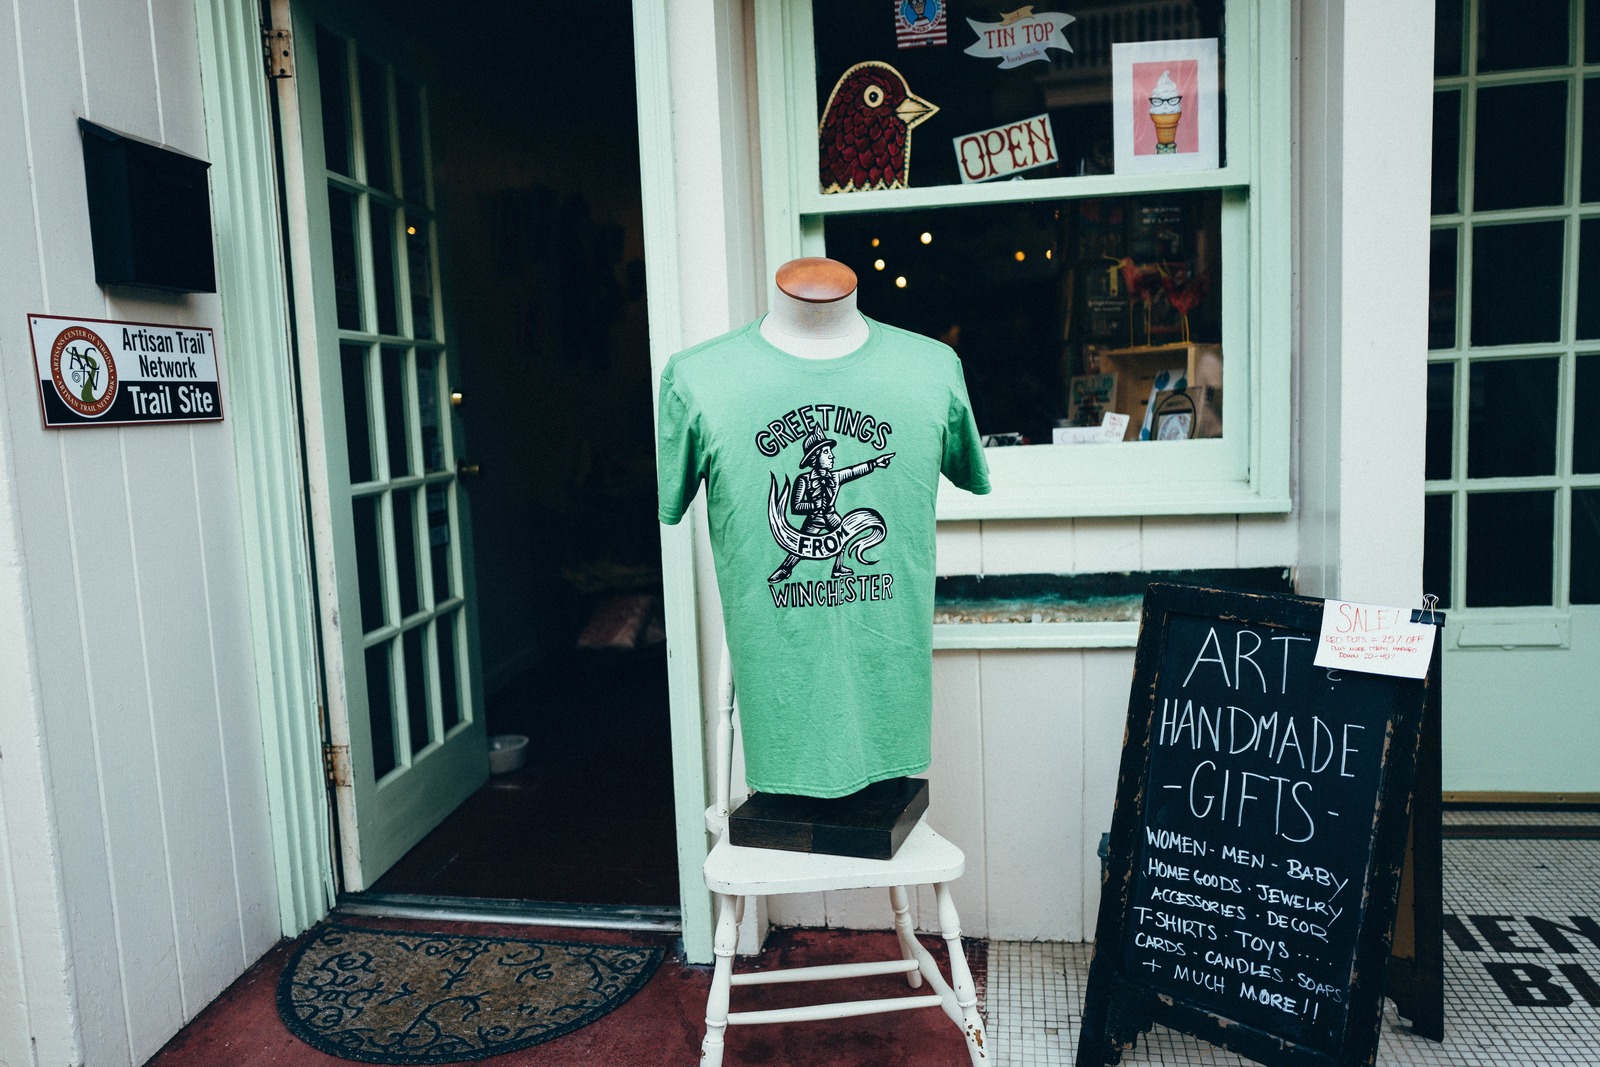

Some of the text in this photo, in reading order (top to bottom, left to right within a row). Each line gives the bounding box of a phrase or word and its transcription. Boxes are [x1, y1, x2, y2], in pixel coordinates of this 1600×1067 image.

[983, 21, 1054, 49] TIN TOP
[1006, 48, 1041, 63] handmade
[960, 117, 1054, 180] OPEN
[53, 329, 114, 373] ARTISANS CENTER OF VIRGINIA
[122, 327, 206, 354] Artisan Trail
[138, 354, 198, 379] Network
[57, 380, 115, 412] ARTISAN TRAIL NETWORK
[127, 385, 214, 415] Trail Site
[755, 404, 892, 457] GREETINGS
[798, 525, 850, 557] FROM
[768, 573, 893, 608] WINCHESTER
[1336, 603, 1400, 633] SALE!
[1325, 635, 1343, 644] RED
[1346, 635, 1367, 644] DOTS
[1405, 635, 1425, 644] OFF
[1182, 627, 1311, 694] ART
[1160, 698, 1365, 777] HANDMADE
[1222, 845, 1265, 869] MEN
[1287, 859, 1349, 903] BABY
[1133, 906, 1217, 941] T-SHIRTS
[1151, 887, 1329, 944] ACCESSORIES DECOR
[1256, 884, 1343, 928] JEWELRY
[1135, 932, 1186, 957] CARDS
[1205, 951, 1284, 983] CANDLES
[1297, 973, 1343, 1003] SOAPS
[1173, 965, 1225, 994] MUCH
